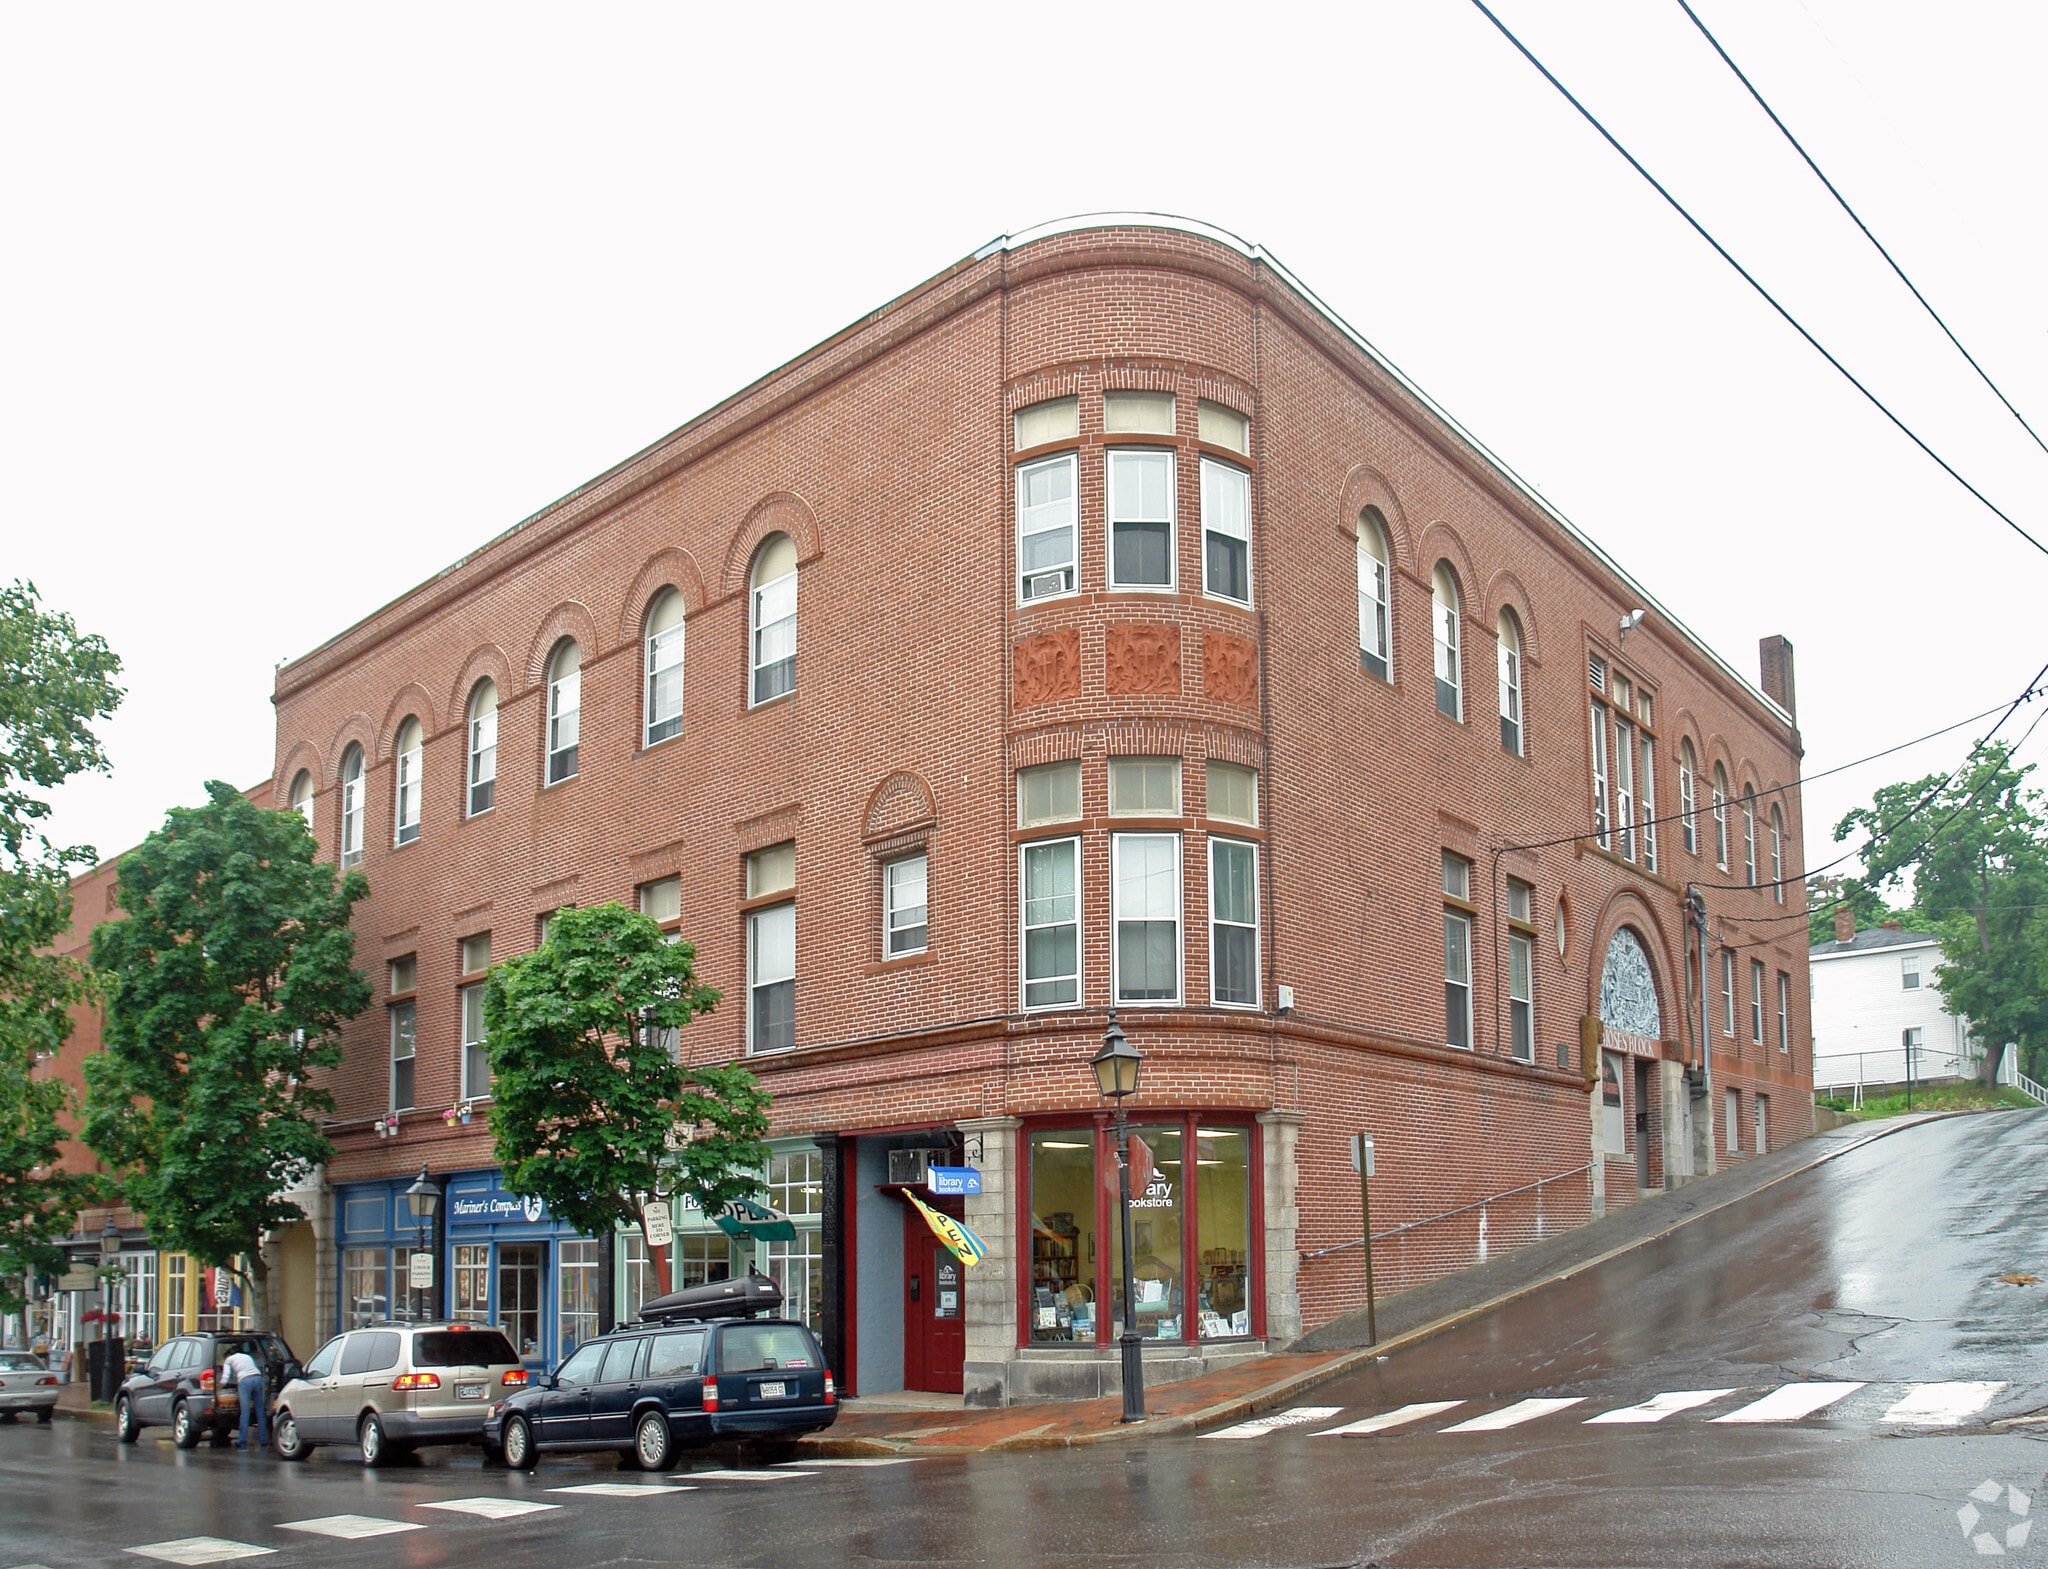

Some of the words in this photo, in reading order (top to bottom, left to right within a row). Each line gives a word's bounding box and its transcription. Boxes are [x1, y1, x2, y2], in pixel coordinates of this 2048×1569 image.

[1629, 1035, 1655, 1058] BLOCK
[939, 1177, 963, 1188] library
[454, 1200, 488, 1215] Mariner's
[1128, 1197, 1173, 1208] ookstore
[939, 1272, 956, 1281] library
